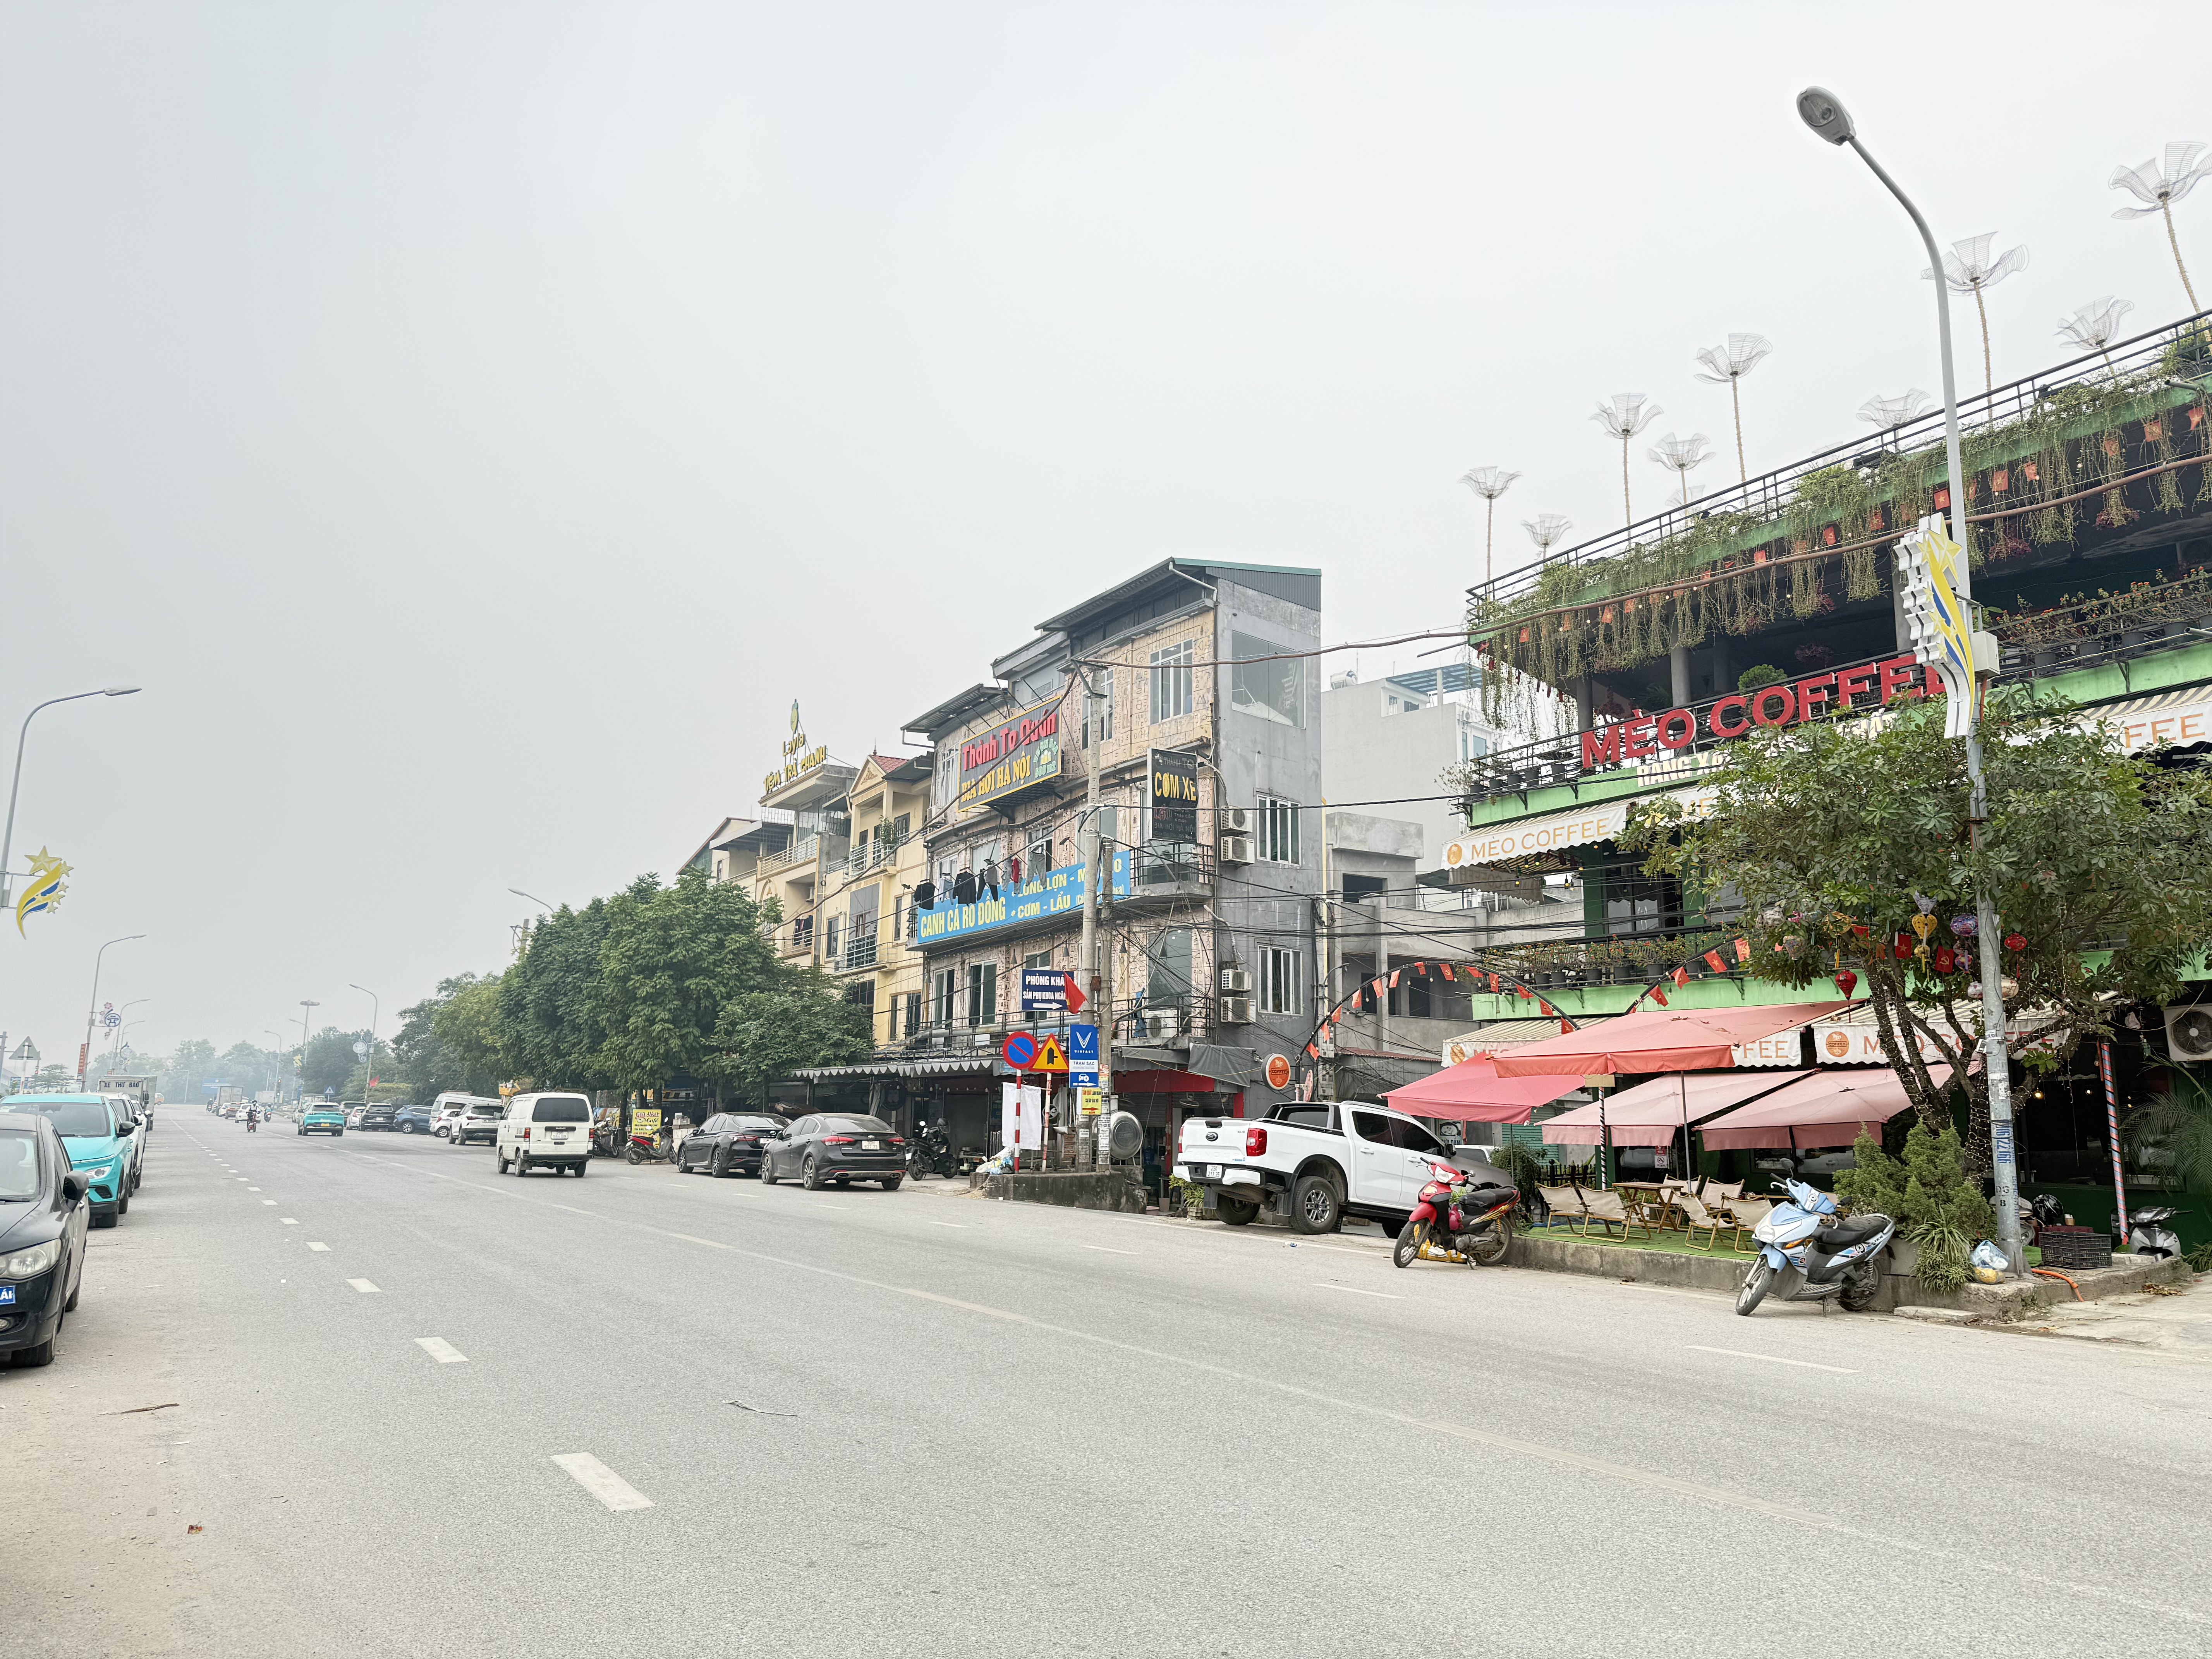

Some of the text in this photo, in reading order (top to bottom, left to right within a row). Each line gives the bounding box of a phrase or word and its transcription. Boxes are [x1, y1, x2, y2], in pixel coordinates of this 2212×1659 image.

[782, 733, 805, 756] Layla
[962, 734, 998, 771] Thành
[1020, 709, 1056, 746] Quán
[1582, 709, 1696, 768] MÈO
[763, 745, 827, 795] TIỆM TRÀ CHANH
[961, 750, 1030, 802] BIA HƠI HÀ NỘI
[1637, 756, 1692, 787] RANG
[1155, 772, 1179, 799] CƠM
[1471, 817, 1611, 860] MÈO COFFEE
[1047, 873, 1067, 891] LỢN
[921, 912, 945, 938] CANH
[947, 904, 960, 932] CÁ
[978, 892, 1006, 925] ĐỒNG
[1018, 902, 1040, 919] CƠM
[1050, 891, 1070, 911] LẨU
[1026, 973, 1065, 986] PHÒNG KHÁ
[1023, 988, 1032, 999] SẢN
[1033, 991, 1042, 1001] PHỤ
[1042, 992, 1054, 1000] KHOA
[0, 1288, 12, 1300] ÁI
